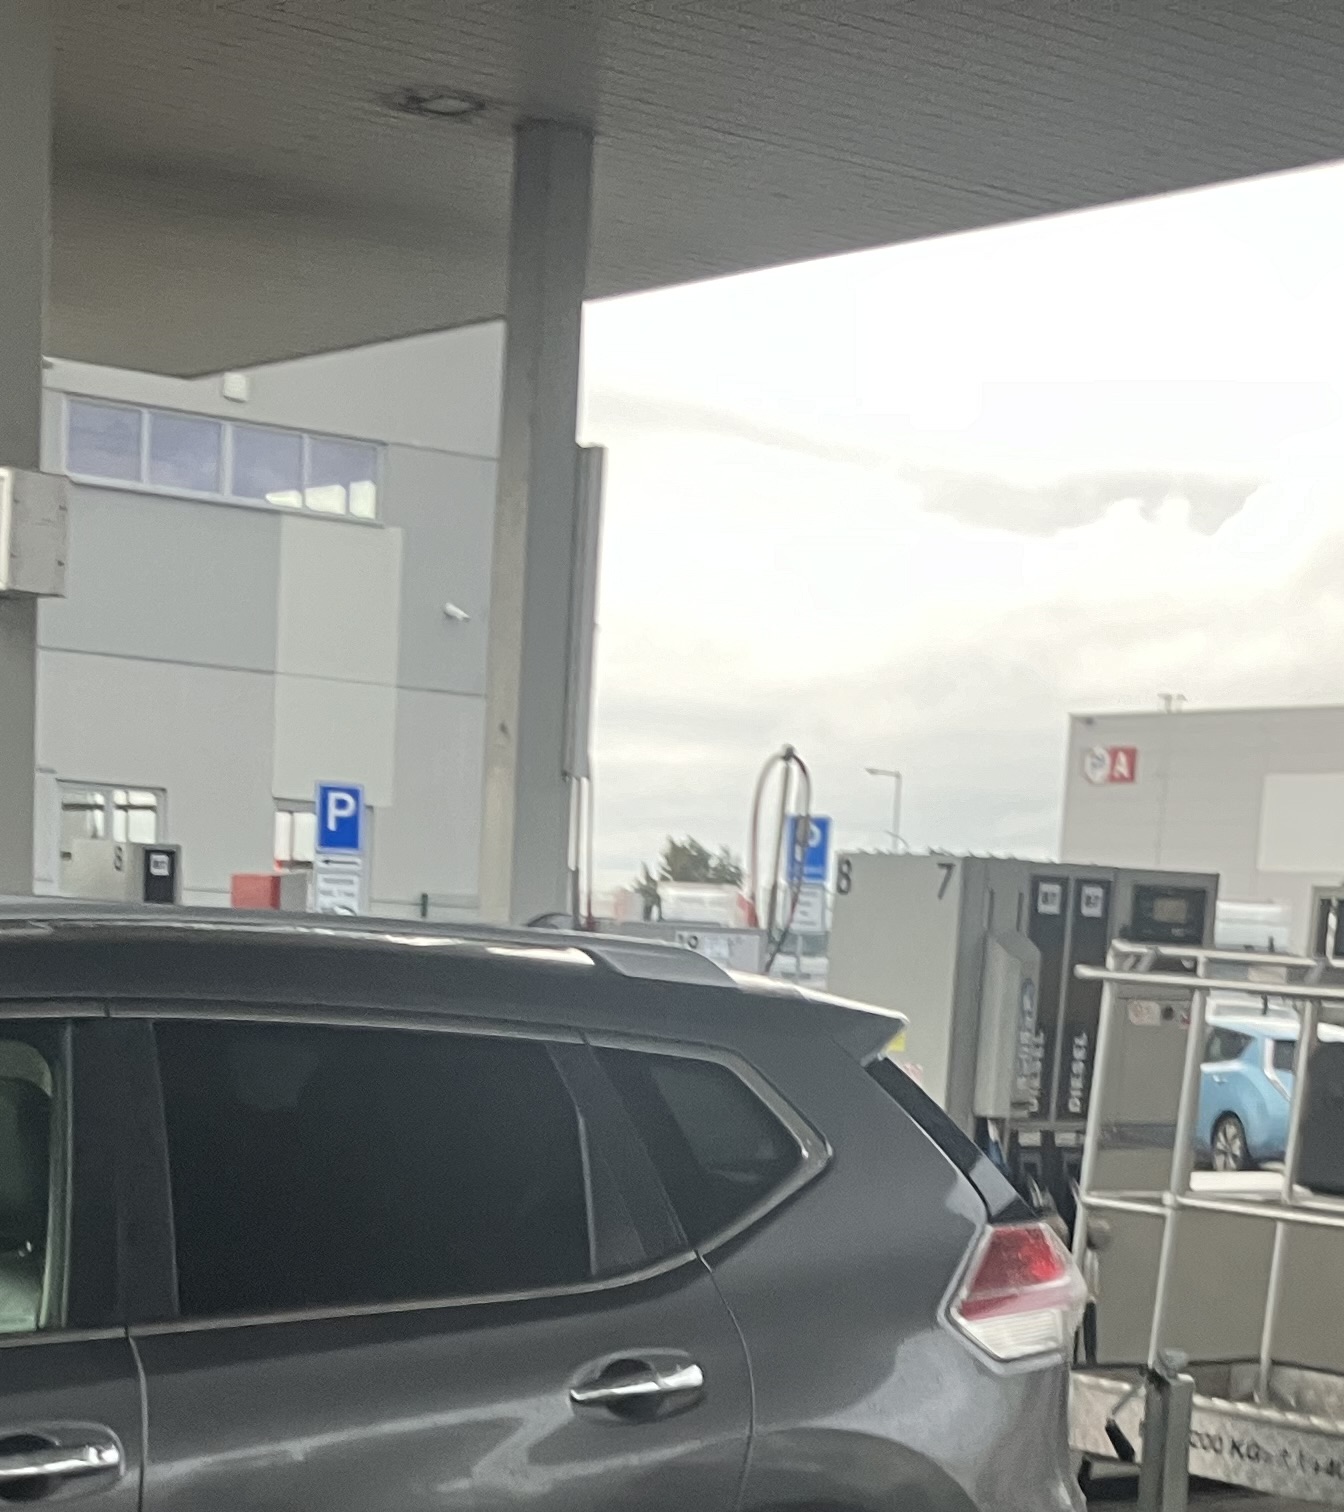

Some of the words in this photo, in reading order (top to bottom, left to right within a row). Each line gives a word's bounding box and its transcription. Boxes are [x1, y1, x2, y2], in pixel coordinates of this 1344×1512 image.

[1115, 750, 1130, 778] A
[326, 791, 356, 832] P
[836, 858, 853, 895] 8
[937, 862, 957, 900] 7
[1067, 1031, 1088, 1113] DIESEL
